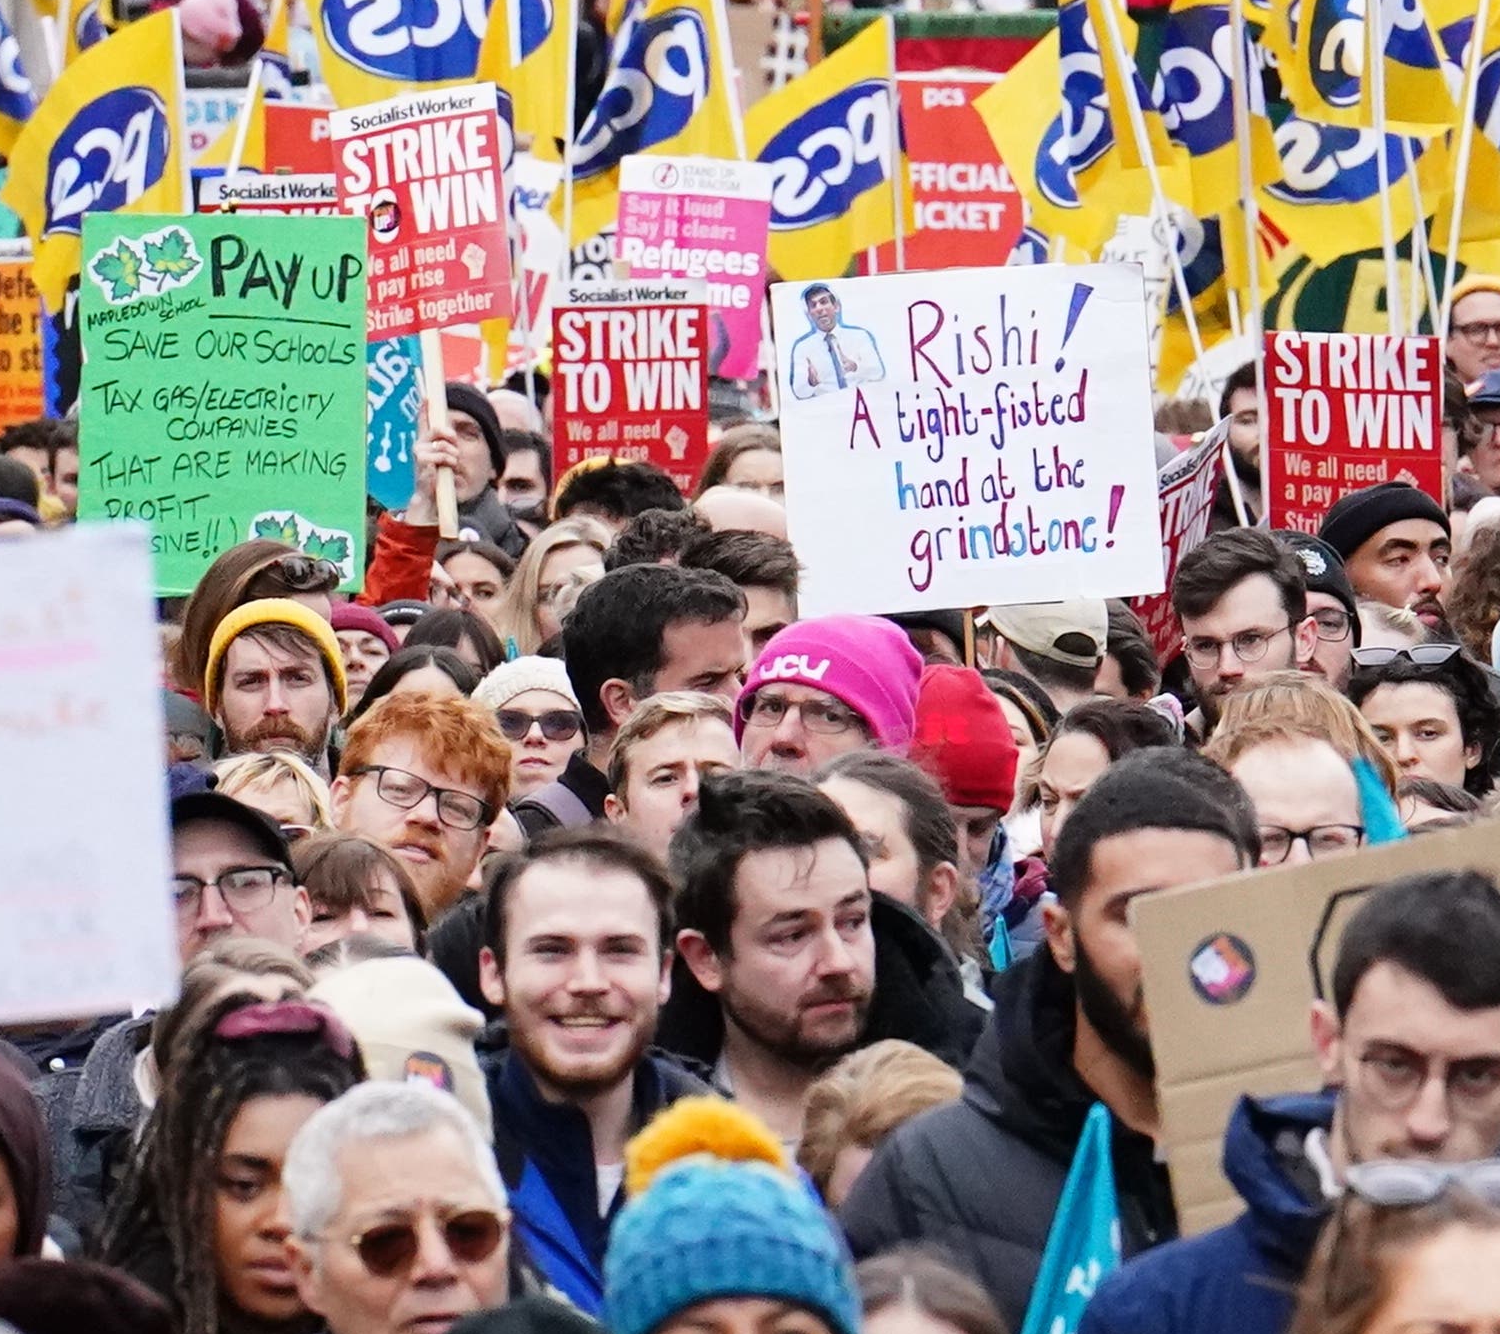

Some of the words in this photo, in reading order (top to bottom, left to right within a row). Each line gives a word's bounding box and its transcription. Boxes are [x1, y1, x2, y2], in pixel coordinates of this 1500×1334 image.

[350, 104, 413, 131] Socialist
[415, 95, 475, 118] Worker
[923, 87, 966, 110] pcs
[341, 116, 492, 195] STRIKE
[219, 183, 288, 201] Socialist
[910, 161, 1017, 193] FFICIAL
[410, 170, 498, 235] WIN
[626, 195, 663, 218] Say
[665, 196, 681, 215] it
[684, 196, 726, 218] loud
[912, 202, 1006, 232] ICKET
[625, 218, 661, 241] Say
[663, 219, 680, 238] it
[682, 220, 737, 240] clear:
[209, 233, 303, 309] PAY
[312, 253, 362, 303] UP
[389, 246, 410, 272] all
[414, 237, 457, 267] need
[621, 236, 761, 277] Refugees
[377, 275, 408, 304] pay
[410, 266, 446, 290] rise
[569, 287, 634, 303] Socialist
[635, 288, 688, 302] Worker
[87, 293, 175, 333] MAPLEDOWN
[158, 296, 207, 323] SCHOOL
[418, 291, 493, 323] together
[104, 329, 179, 361] SAVE
[195, 330, 251, 361] OUR
[254, 333, 357, 366] SCHOOLS
[557, 308, 701, 361] STRIKE
[907, 283, 1095, 389] Rishi!
[1273, 331, 1432, 392] STRIKE
[92, 380, 143, 413] TAX
[557, 362, 612, 413] TO
[621, 361, 701, 412] WIN
[567, 420, 592, 441] We
[599, 420, 620, 440] all
[622, 419, 662, 441] need
[850, 386, 881, 450] A
[896, 368, 1089, 463] tight-fisted
[1274, 387, 1332, 446] TO
[1343, 393, 1434, 451] WIN
[89, 451, 162, 492] THAT
[172, 450, 231, 480] ARE
[245, 450, 348, 480] MAKING
[894, 457, 970, 510] hand
[981, 457, 1016, 503] at
[1032, 445, 1085, 492] the
[1283, 453, 1312, 477] We
[1317, 455, 1338, 480] all
[1343, 458, 1388, 482] need
[104, 494, 210, 522] PROFIT
[1284, 483, 1296, 501] a
[1302, 484, 1334, 509] pay
[907, 484, 1126, 592] grindstone!
